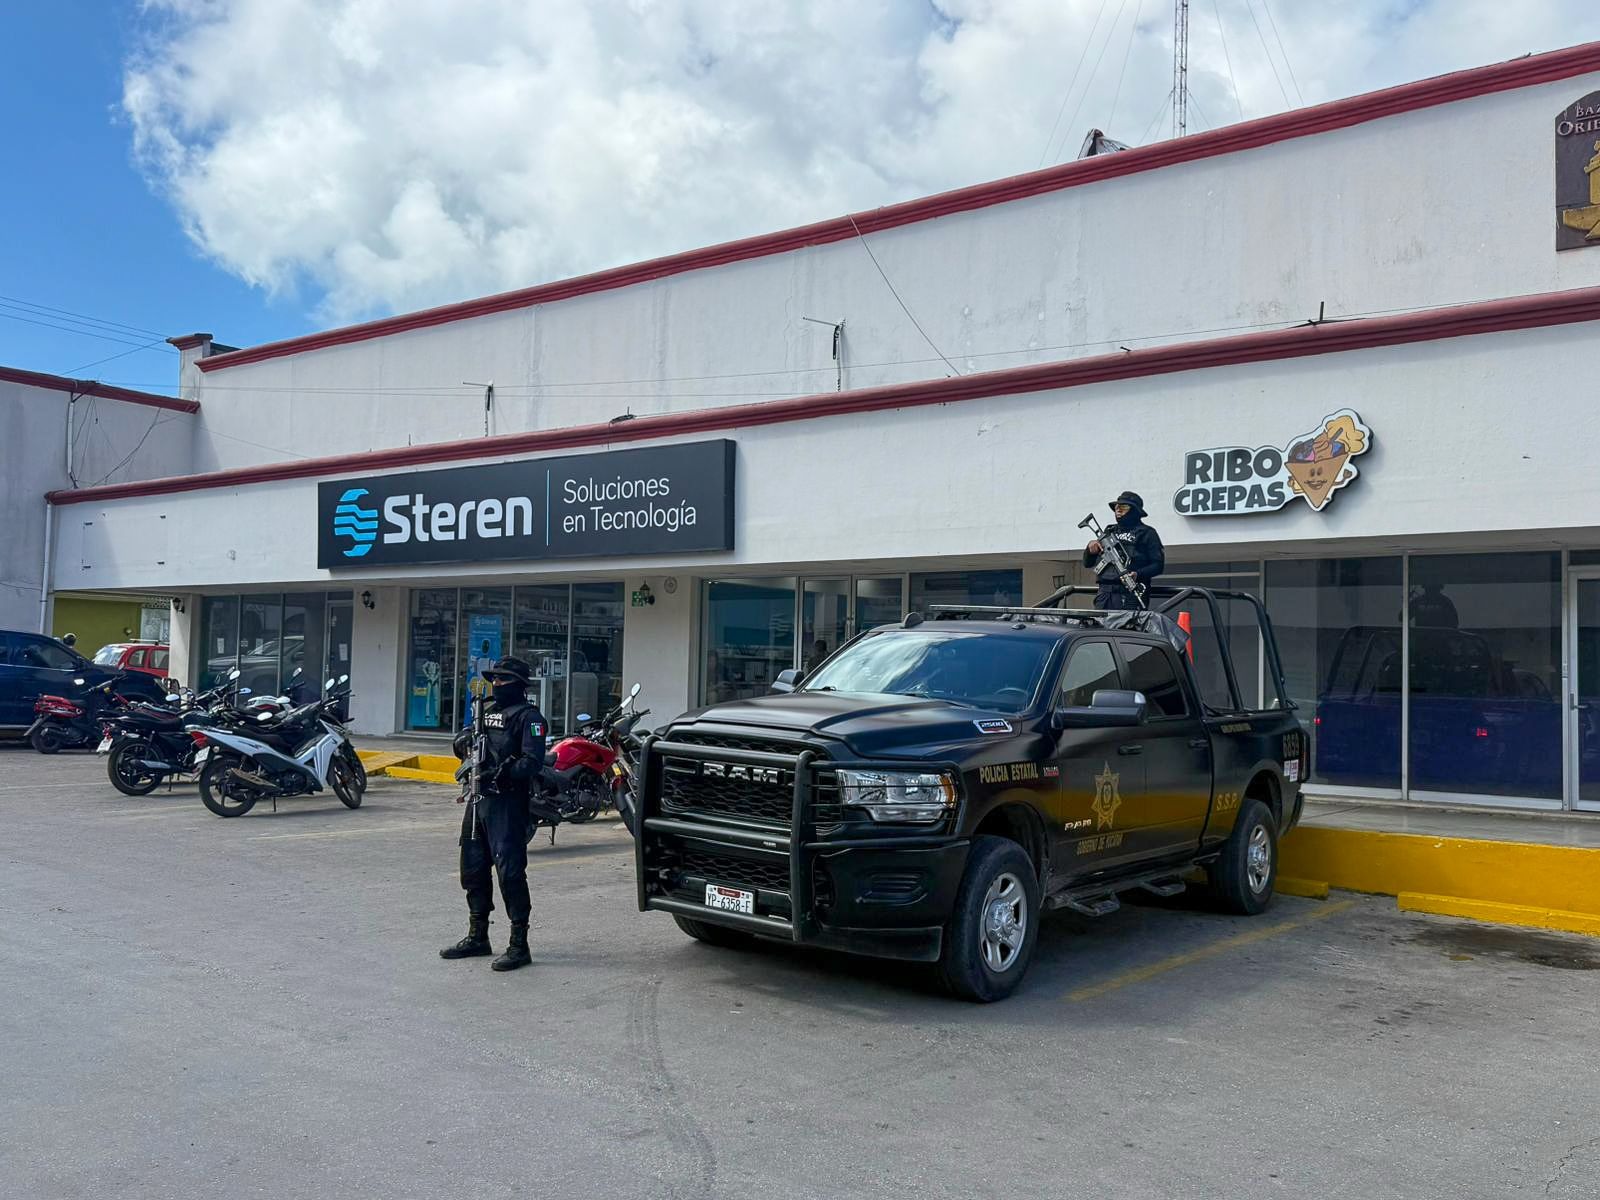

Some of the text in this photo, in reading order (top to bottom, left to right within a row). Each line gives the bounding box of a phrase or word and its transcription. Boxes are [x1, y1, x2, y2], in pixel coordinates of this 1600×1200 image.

[1186, 448, 1282, 485] RIBO
[563, 475, 670, 504] Soluciones
[1174, 481, 1286, 513] CREPAS
[383, 494, 533, 544] Steren
[563, 499, 697, 534] en Tecnología
[703, 762, 779, 784] RAM
[979, 764, 1009, 784] POLICIA
[1011, 762, 1039, 781] ESTATAL
[1064, 818, 1092, 831] RAM
[707, 893, 751, 913] YP-6358-F
